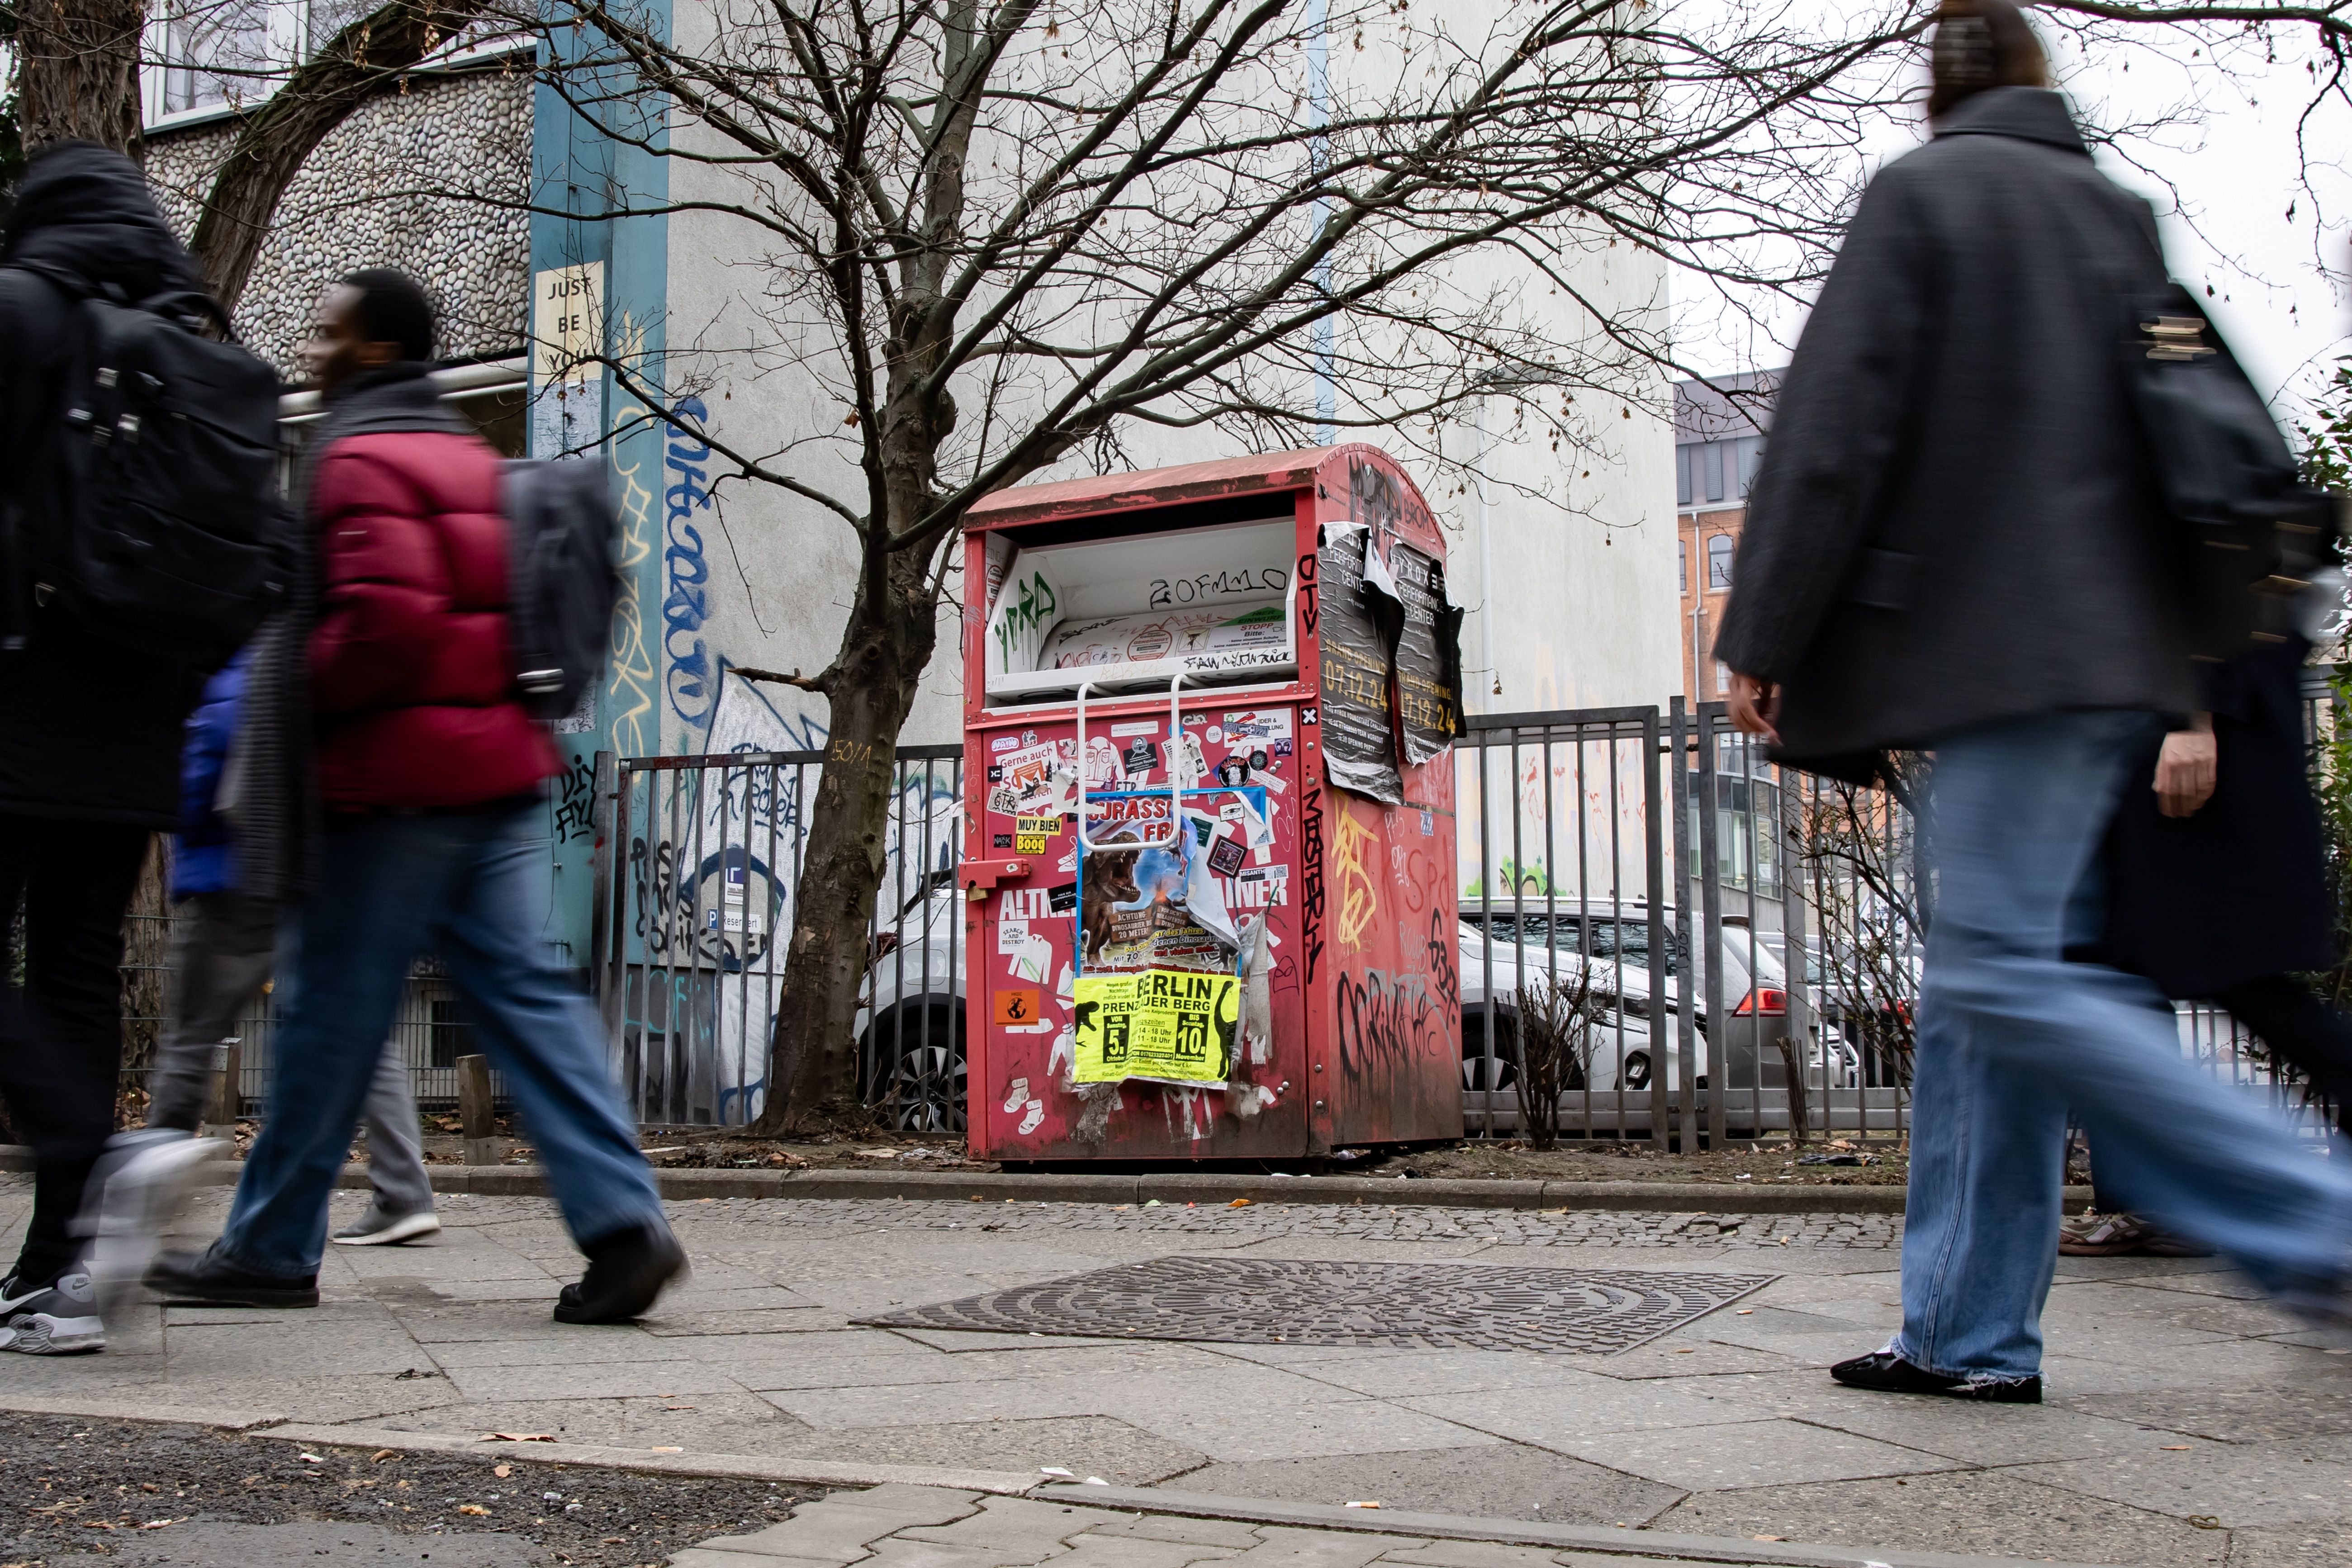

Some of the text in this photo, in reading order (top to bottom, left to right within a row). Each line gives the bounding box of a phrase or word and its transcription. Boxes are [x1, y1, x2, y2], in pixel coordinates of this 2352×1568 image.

[548, 277, 591, 300] JUST
[559, 315, 579, 333] BE
[1238, 615, 1282, 624] EINWURF
[1410, 604, 1435, 627] CENTER
[1240, 623, 1274, 631] STOPP
[1326, 639, 1386, 677] GRAND OPENING
[1325, 660, 1389, 712] 07.12.24
[1422, 677, 1451, 701] OPENING
[1370, 719, 1390, 734] CHALLENGE
[1357, 727, 1367, 738] TEAM
[1367, 731, 1384, 744] WORKOUT
[1363, 741, 1375, 754] PARTY
[1001, 746, 1052, 768] Gerne auch
[1018, 819, 1060, 832] MUY BIEN
[1017, 835, 1045, 854] Boog
[709, 911, 758, 928] P Reserert
[1161, 907, 1182, 917] VORSICHT
[1003, 928, 1024, 936] SEARCH
[1112, 921, 1145, 932] DINOSAURIER
[1129, 927, 1149, 938] METER!
[1162, 920, 1175, 929] DINO
[1126, 952, 1138, 962] 70
[1169, 947, 1194, 956] vielem
[1137, 974, 1212, 1000] BERLIN
[1174, 999, 1210, 1011] BERG
[1109, 1029, 1124, 1055] 5.
[1178, 1027, 1205, 1054] 10.
